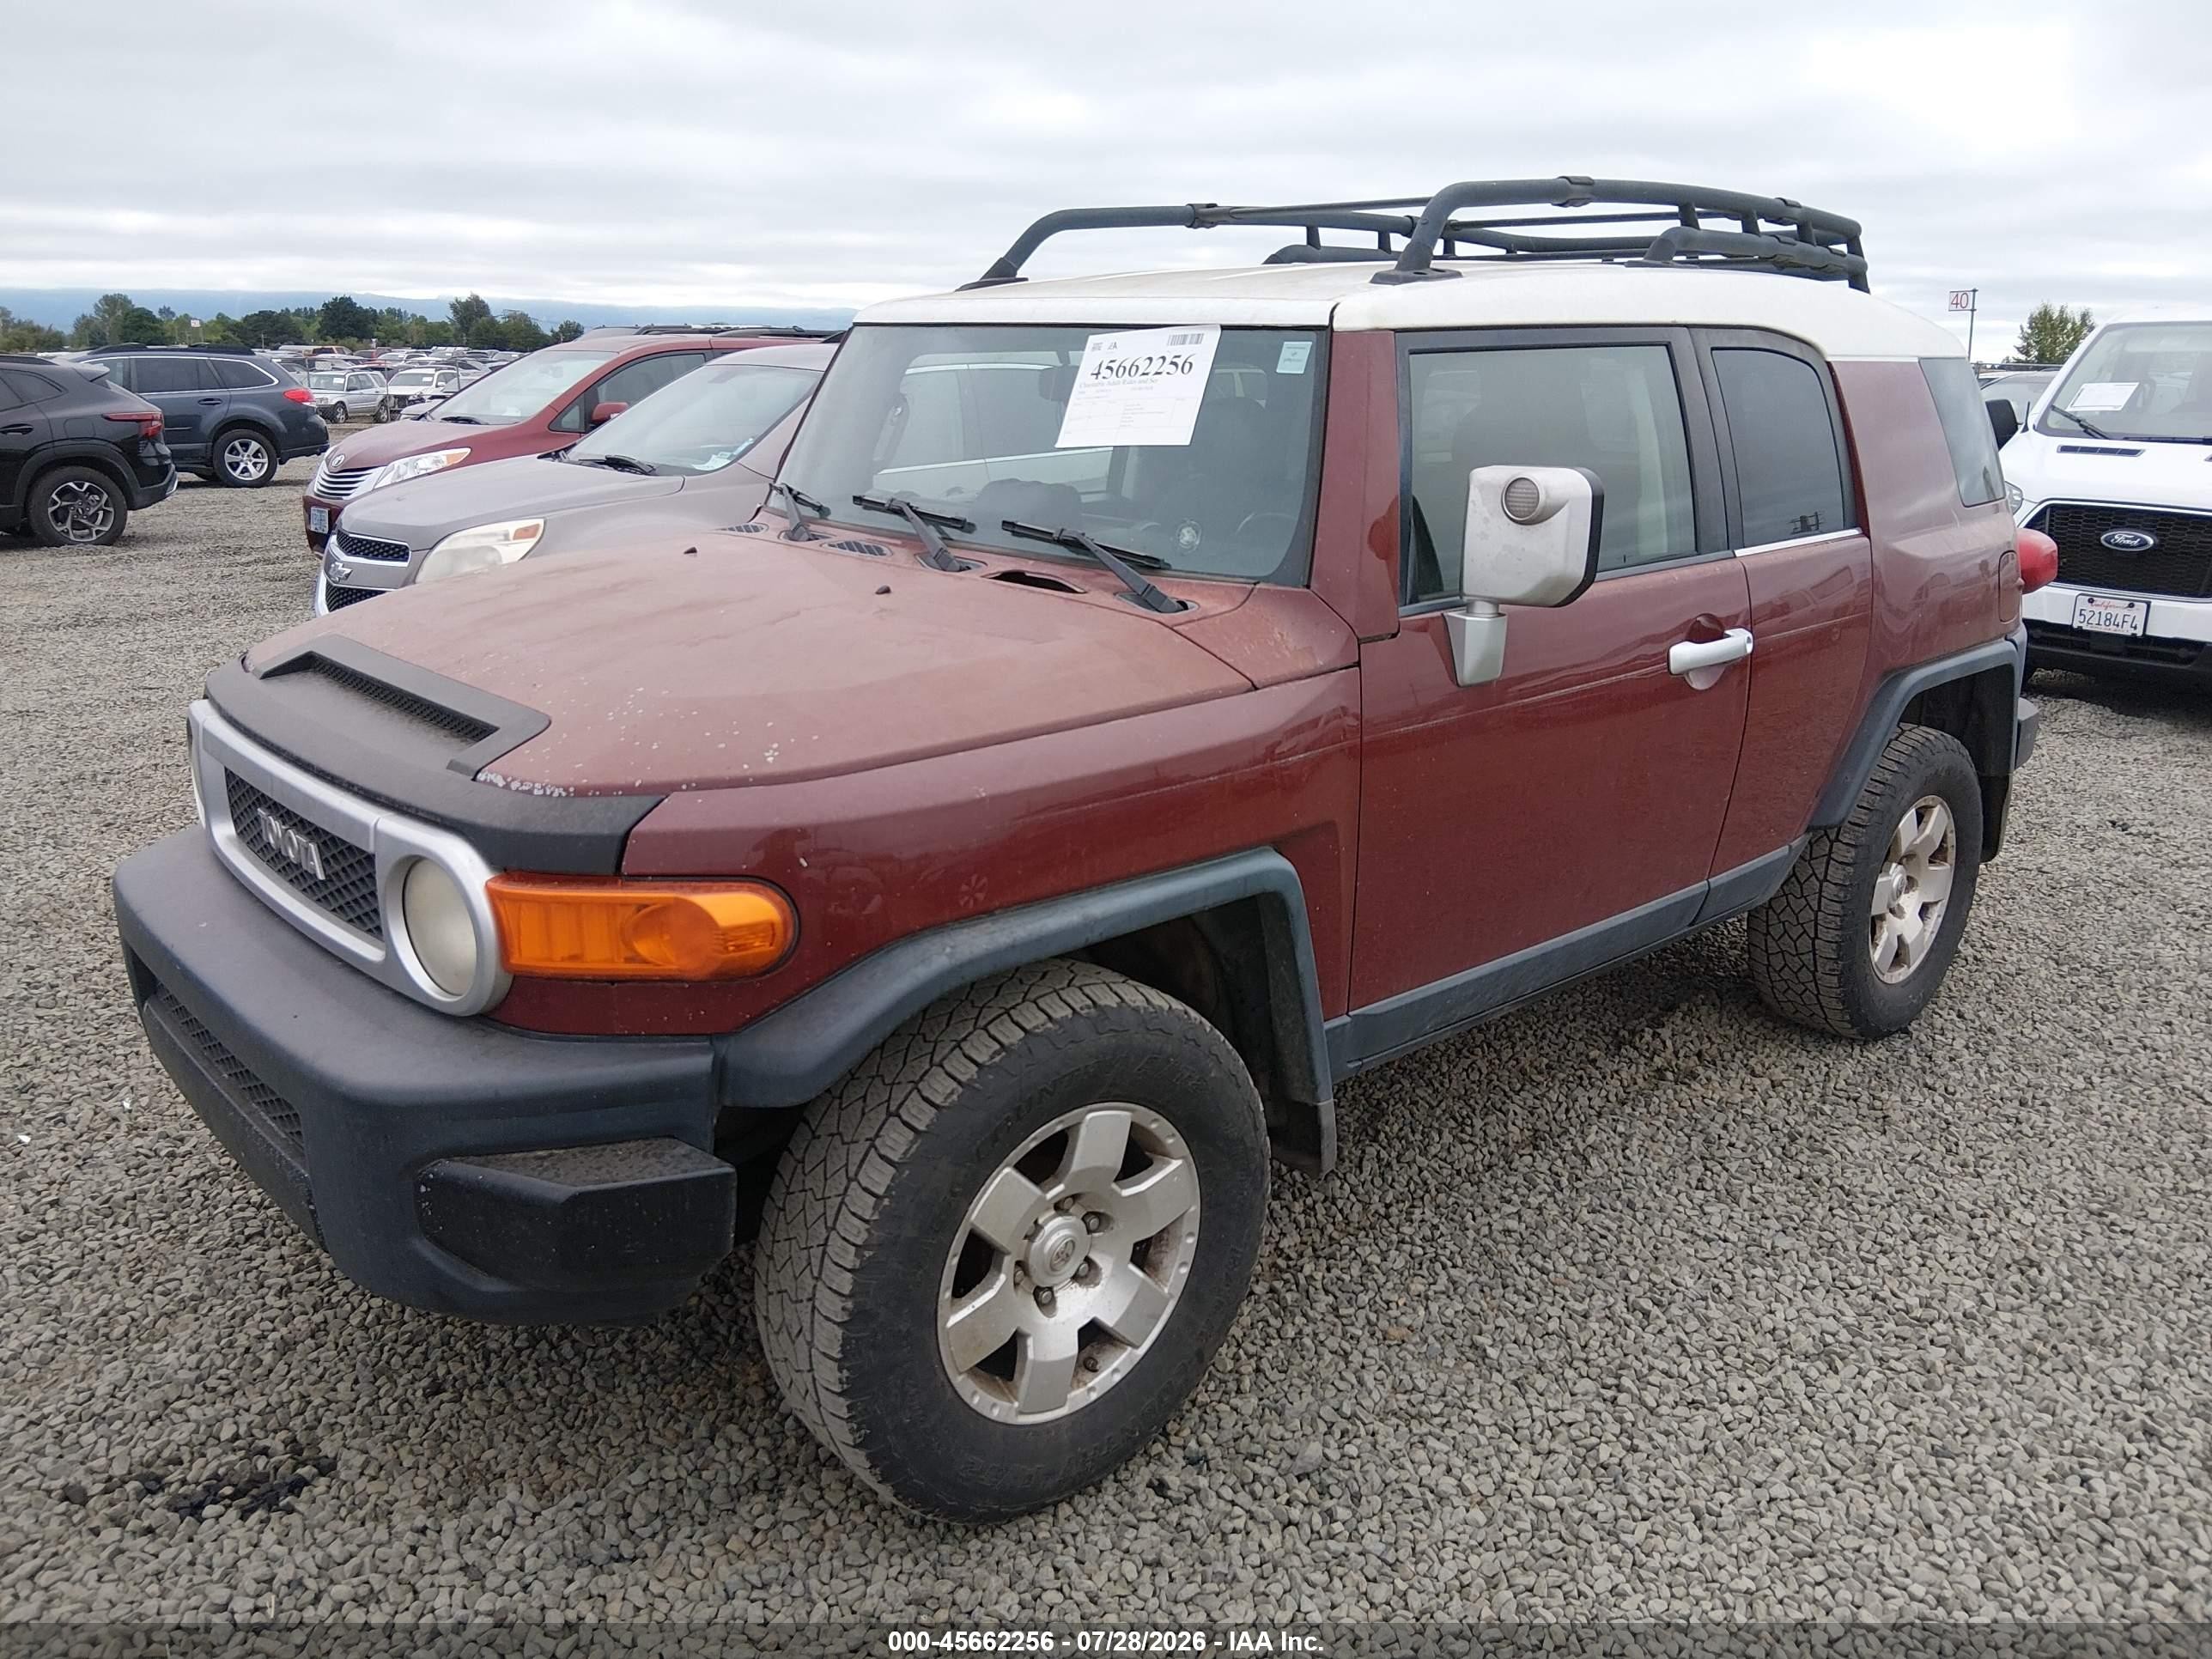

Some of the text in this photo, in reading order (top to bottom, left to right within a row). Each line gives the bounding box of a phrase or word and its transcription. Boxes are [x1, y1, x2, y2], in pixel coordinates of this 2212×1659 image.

[1950, 292, 1969, 308] 40
[1091, 353, 1195, 380] 45662256
[2110, 533, 2141, 547] Ford
[2078, 608, 2138, 631] 52184F4
[257, 807, 326, 880] TOYOTA
